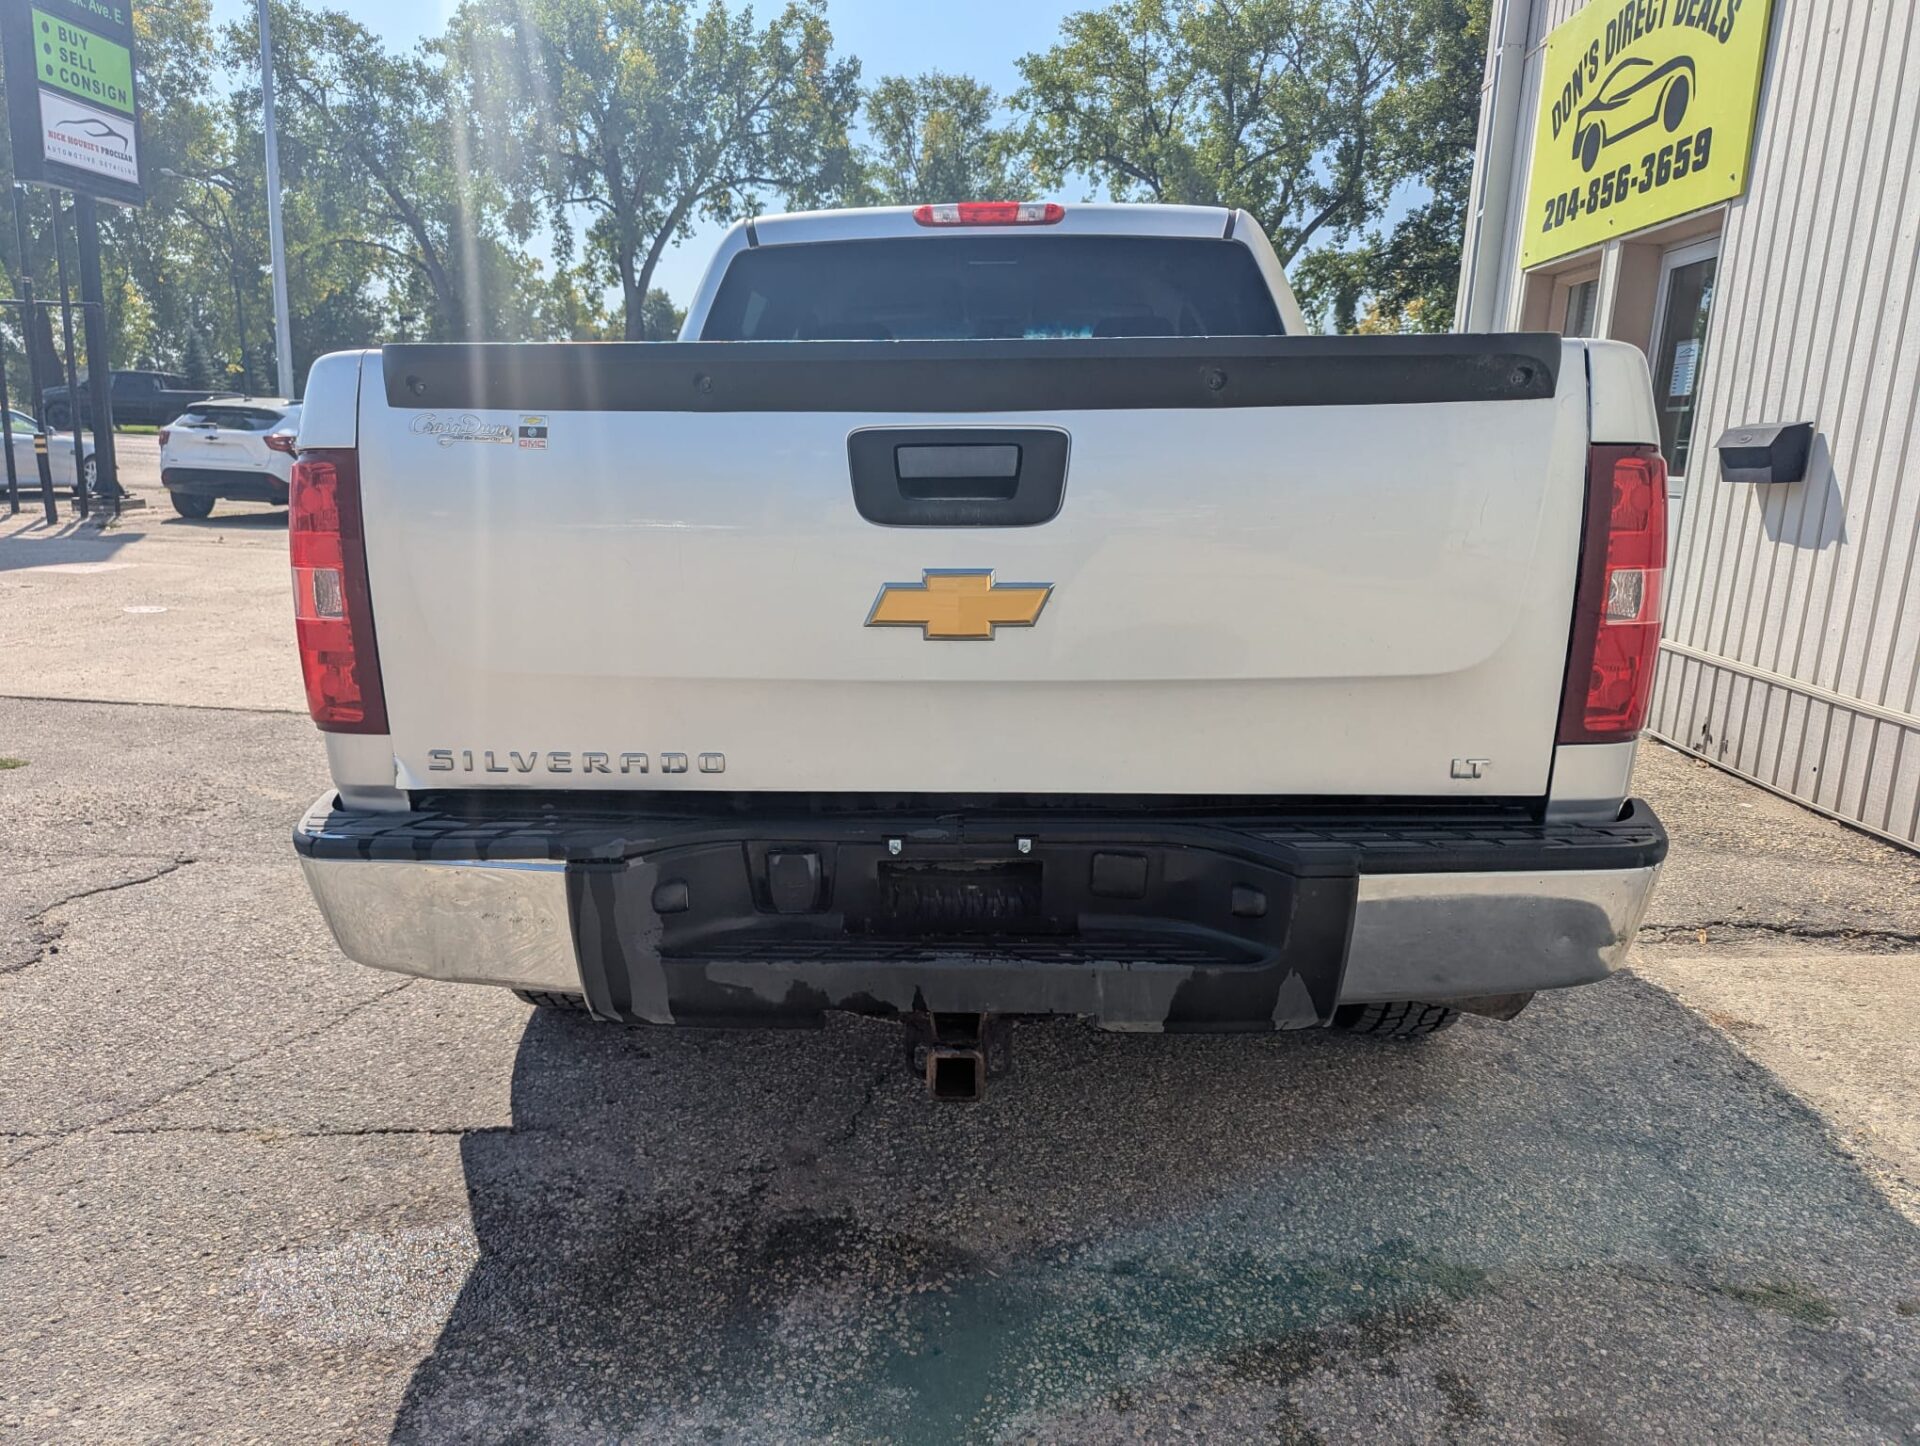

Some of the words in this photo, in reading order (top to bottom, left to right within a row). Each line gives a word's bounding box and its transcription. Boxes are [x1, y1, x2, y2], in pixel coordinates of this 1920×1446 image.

[57, 26, 88, 50] BUY
[59, 47, 97, 74] SELL
[1551, 38, 1600, 141] DON'S
[1604, 0, 1668, 66] DIRECT
[1672, 0, 1743, 44] DEALS
[60, 68, 127, 105] CONSIGN
[1542, 127, 1713, 233] 204-856-3659
[518, 438, 547, 449] GMC
[428, 749, 727, 774] SILVERADO
[1450, 758, 1490, 779] LT
